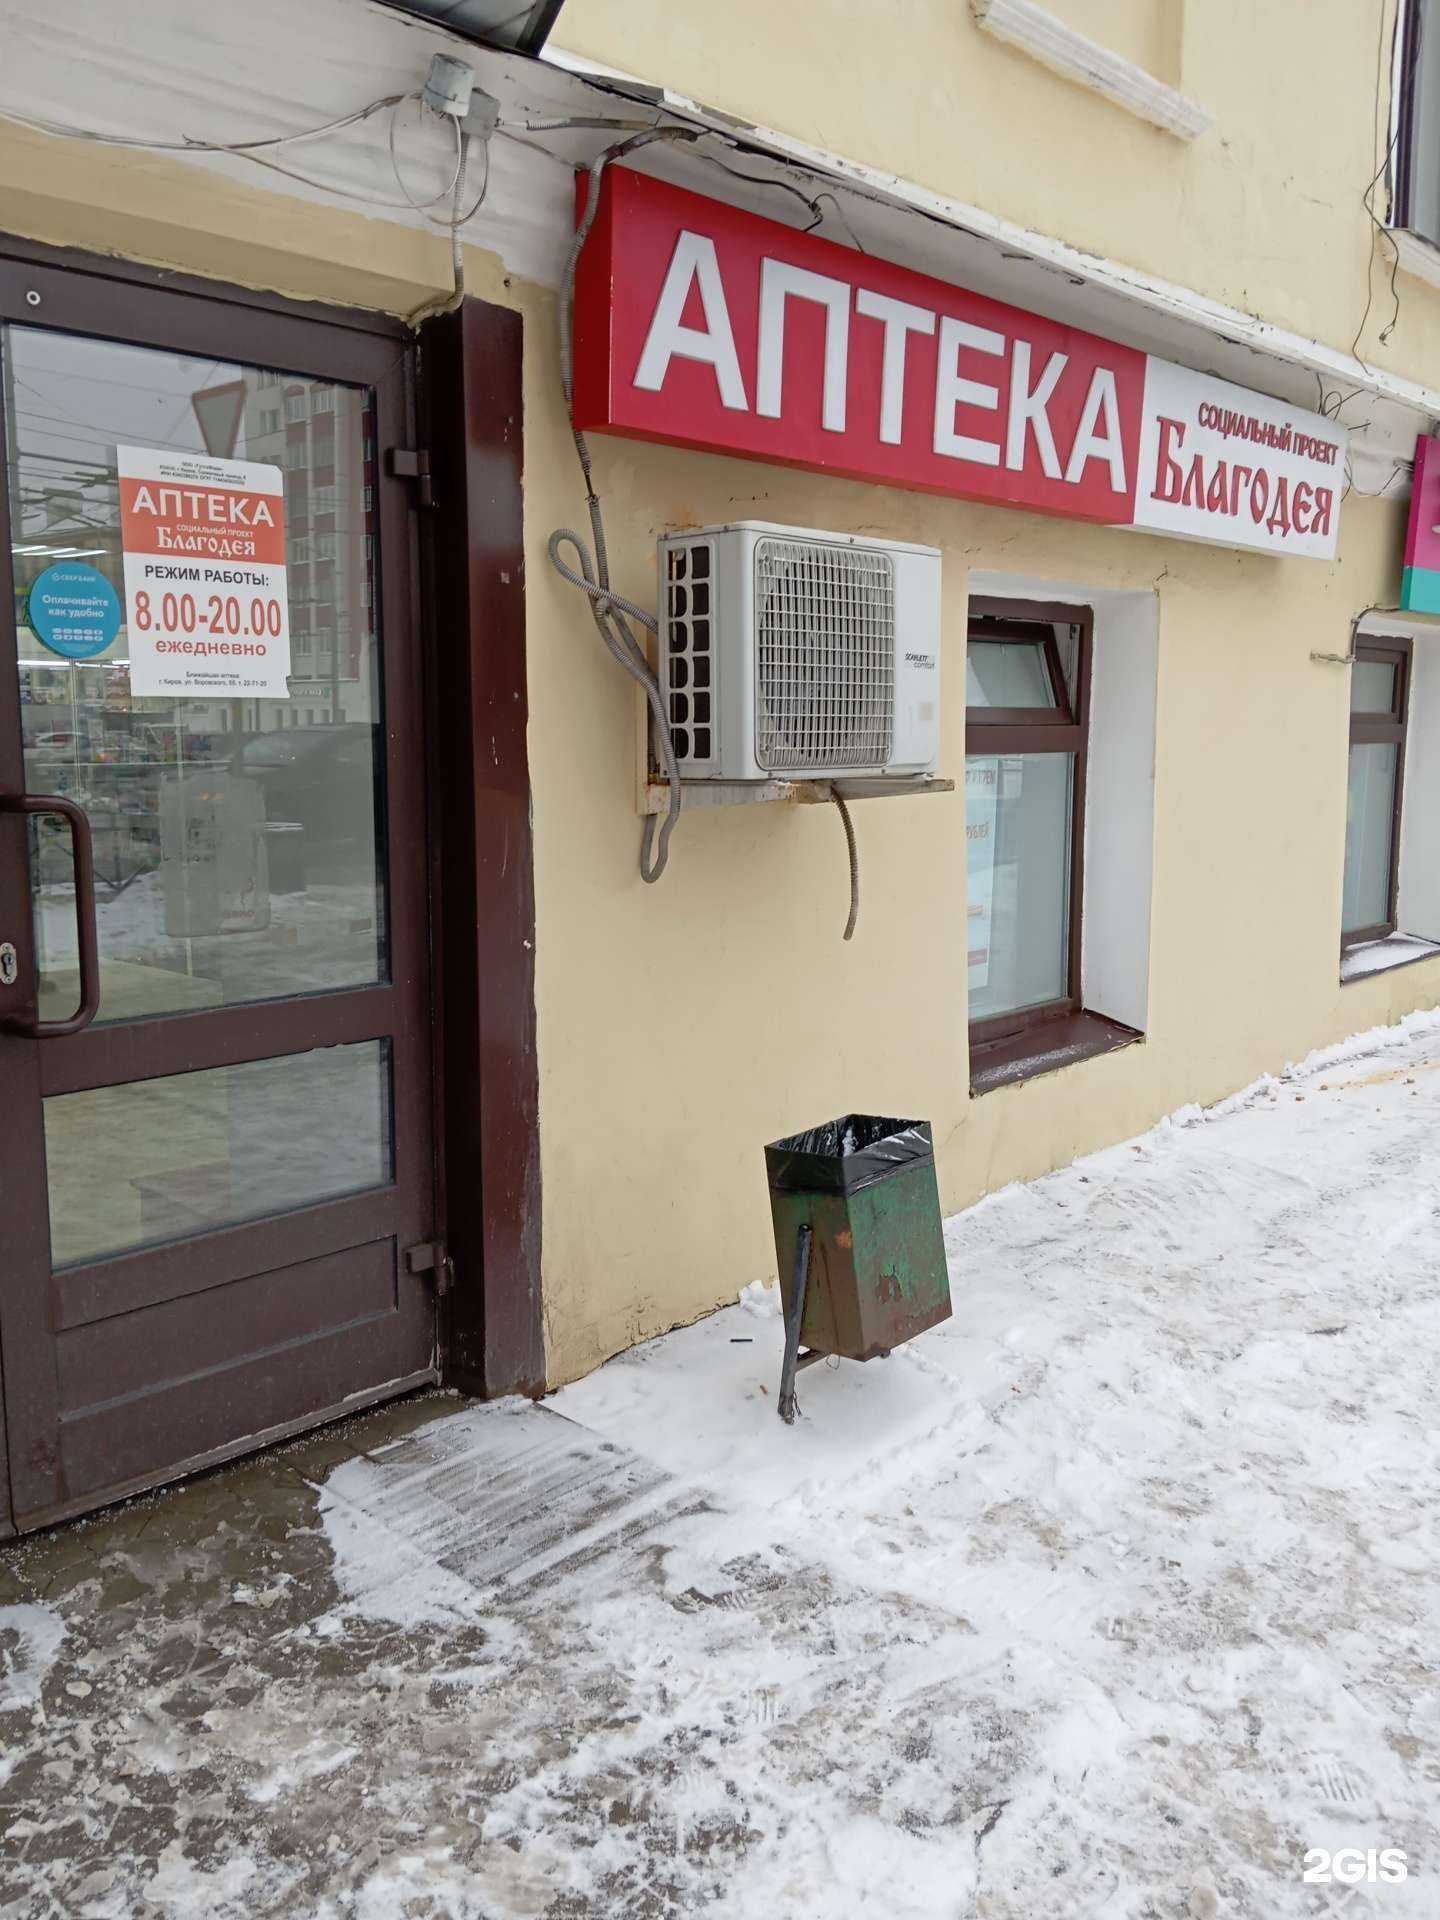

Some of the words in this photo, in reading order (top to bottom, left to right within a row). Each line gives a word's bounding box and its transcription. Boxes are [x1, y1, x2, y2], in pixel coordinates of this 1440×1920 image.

[633, 229, 1128, 494] АПТЕКА
[1198, 401, 1292, 453] СОЦИАЛЬНЫЙ
[1292, 431, 1340, 466] ПРОЕКТ
[1150, 415, 1334, 538] Благодея
[132, 485, 275, 528] АПТЕКА
[156, 526, 256, 558] Благодея
[176, 523, 227, 535] СОЦИАЛЬНЫЙ
[227, 528, 254, 539] ПРОЕКТ
[144, 564, 200, 582] РЕЖИМ
[204, 569, 270, 587] РАБОТЫ:
[42, 594, 109, 607] Оплачивайте
[48, 608, 66, 616] как
[69, 608, 104, 618] удобно
[135, 590, 282, 638] 8.00-20.00
[155, 639, 267, 657] ежедневно
